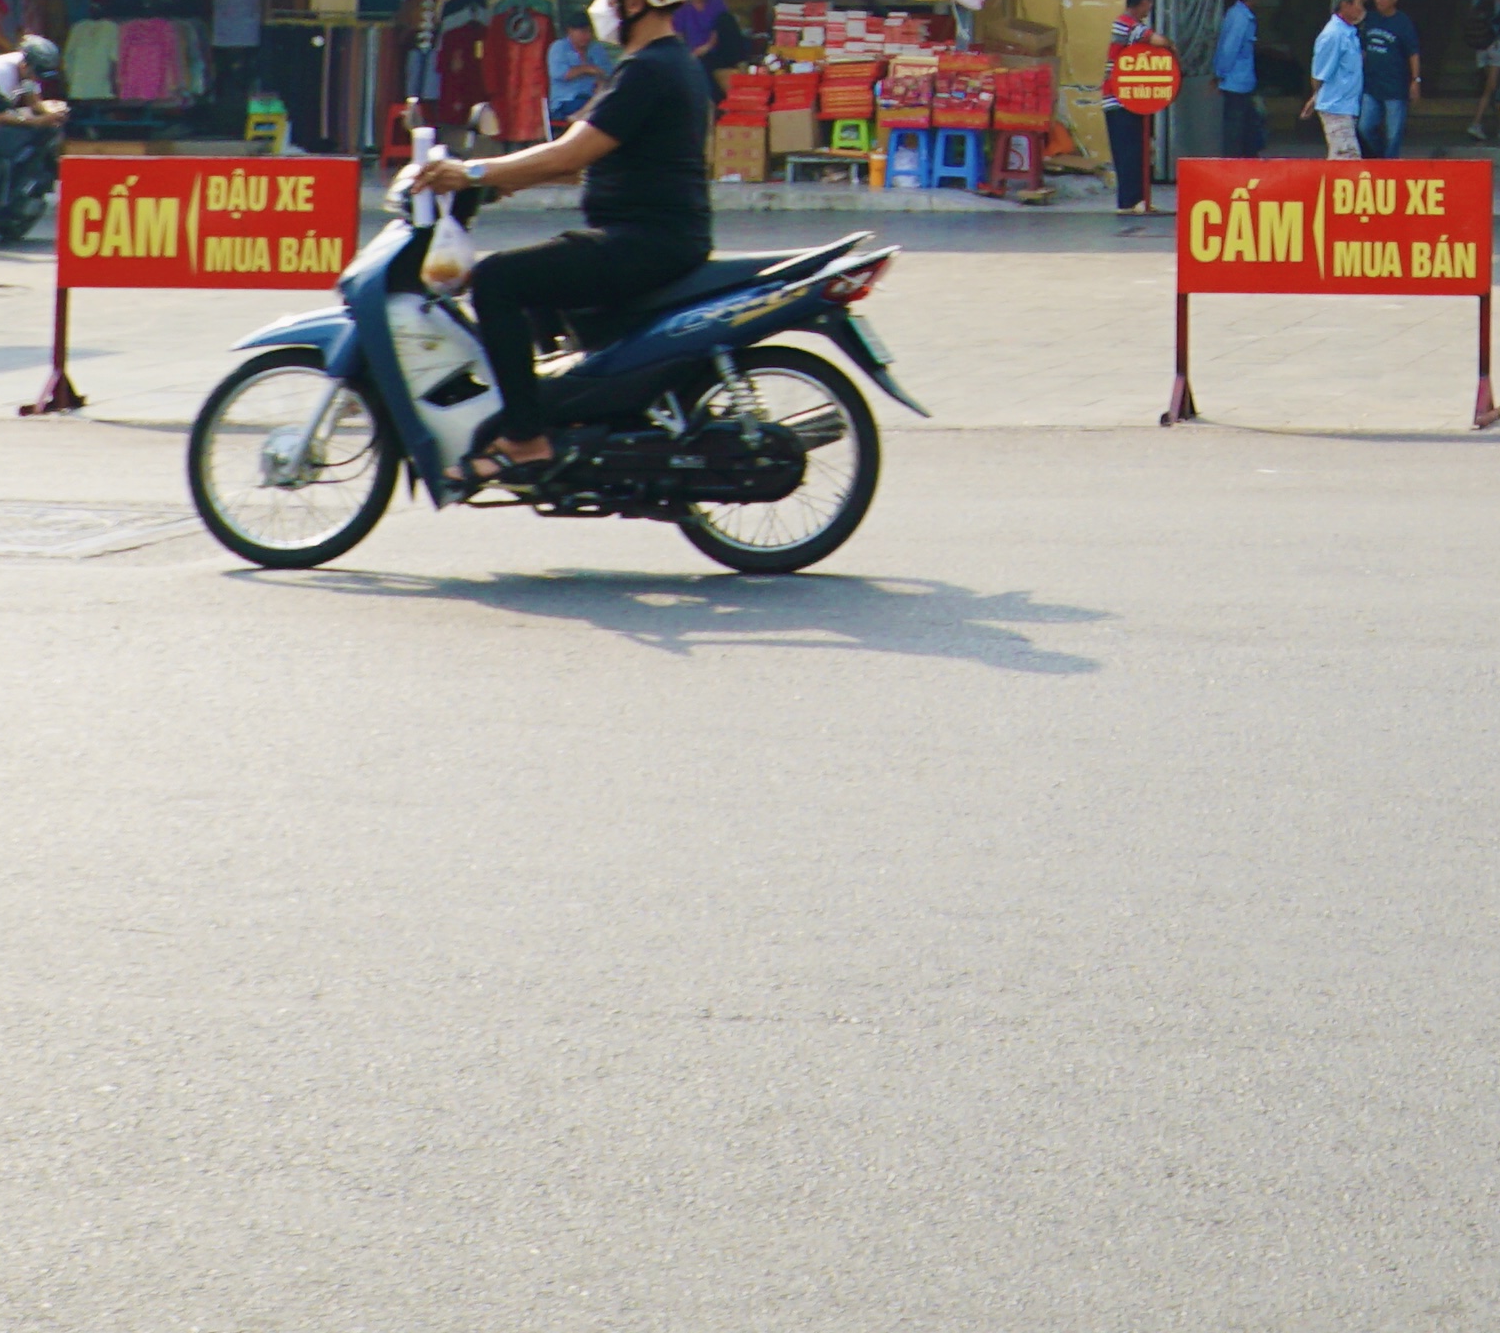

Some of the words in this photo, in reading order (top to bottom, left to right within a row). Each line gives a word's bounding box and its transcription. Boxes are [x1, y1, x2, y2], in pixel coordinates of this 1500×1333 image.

[1119, 51, 1172, 71] CẤM
[1119, 86, 1131, 99] XE
[1132, 84, 1152, 99] VÀO
[1153, 85, 1173, 101] CHỢ
[69, 175, 180, 258] CẤM
[206, 168, 269, 219] ĐẬU
[274, 176, 315, 211] XE
[1333, 171, 1396, 223] ĐẬU
[1405, 179, 1445, 215] XE
[1190, 178, 1304, 263] CẤM
[204, 237, 271, 273] MUA
[278, 230, 342, 273] BÁN
[1333, 241, 1403, 278] MUA
[1411, 234, 1477, 278] BÁN
